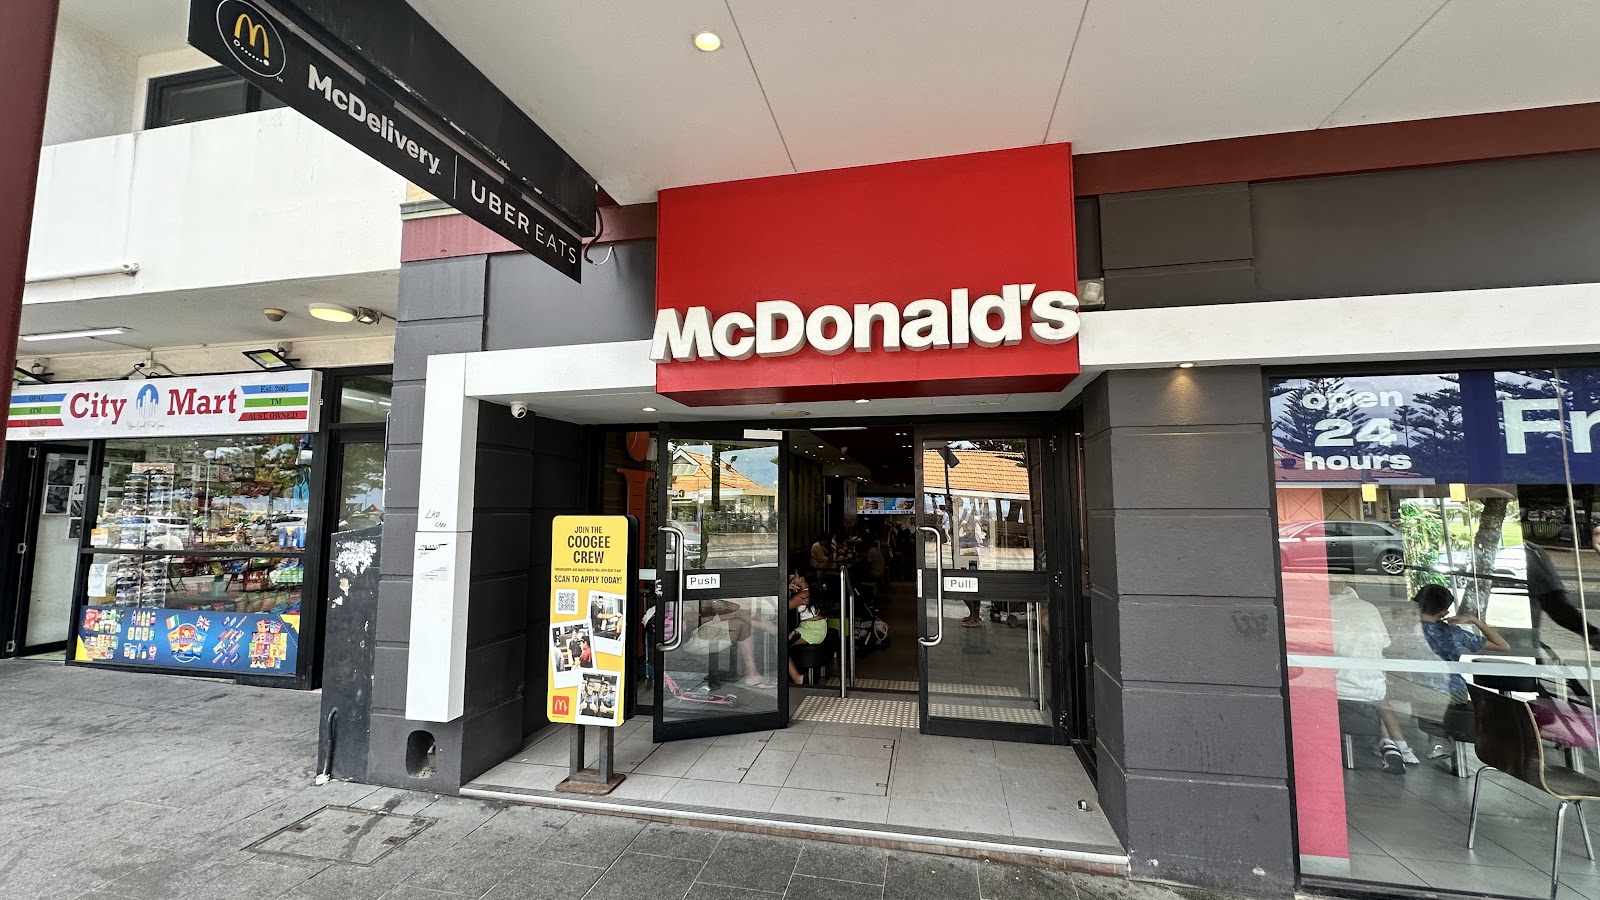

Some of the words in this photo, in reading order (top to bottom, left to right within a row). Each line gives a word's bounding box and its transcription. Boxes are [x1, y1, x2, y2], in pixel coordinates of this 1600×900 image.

[308, 63, 440, 175] McDelivery
[471, 179, 530, 235] UBER
[535, 223, 577, 264] EATS
[649, 284, 1081, 364] McDonald's
[260, 385, 273, 393] Est.
[69, 391, 127, 425] City
[167, 387, 237, 416] Mart
[1302, 390, 1404, 415] open
[270, 411, 298, 420] OWNED
[1314, 417, 1398, 448] 24
[1303, 451, 1412, 471] hours
[574, 526, 589, 534] JOIN
[591, 526, 602, 534] THE
[567, 535, 611, 549] COOGEE
[573, 550, 605, 564] CREW
[554, 575, 570, 583] SCAN
[571, 575, 580, 583] TO
[580, 576, 599, 584] APPLY
[601, 576, 623, 585] TODAY!
[690, 576, 717, 586] Push
[950, 579, 971, 589] Pull
